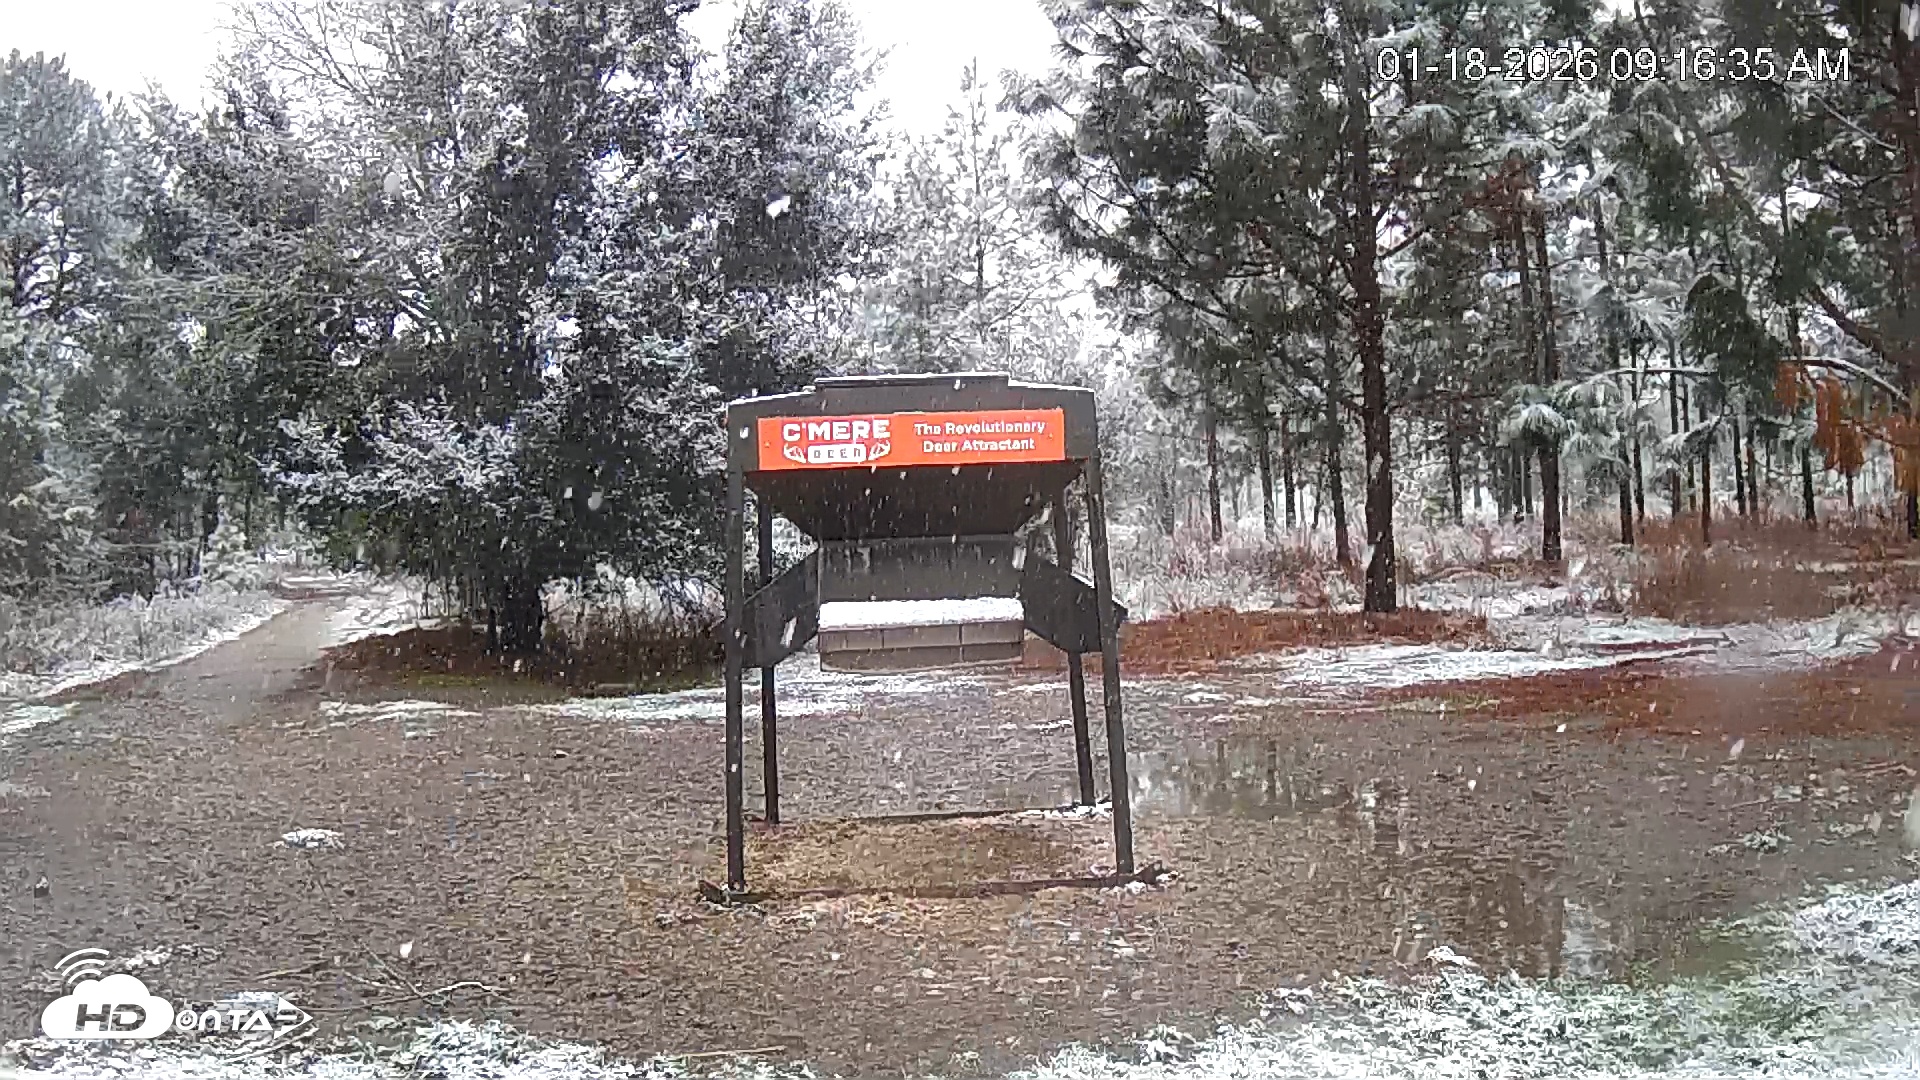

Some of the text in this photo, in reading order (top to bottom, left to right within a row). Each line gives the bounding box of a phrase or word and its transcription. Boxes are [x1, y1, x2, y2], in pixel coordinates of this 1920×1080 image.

[783, 419, 891, 442] C'MERE
[914, 420, 1046, 435] The Revolutionary
[923, 438, 1036, 453] Deer Attractant
